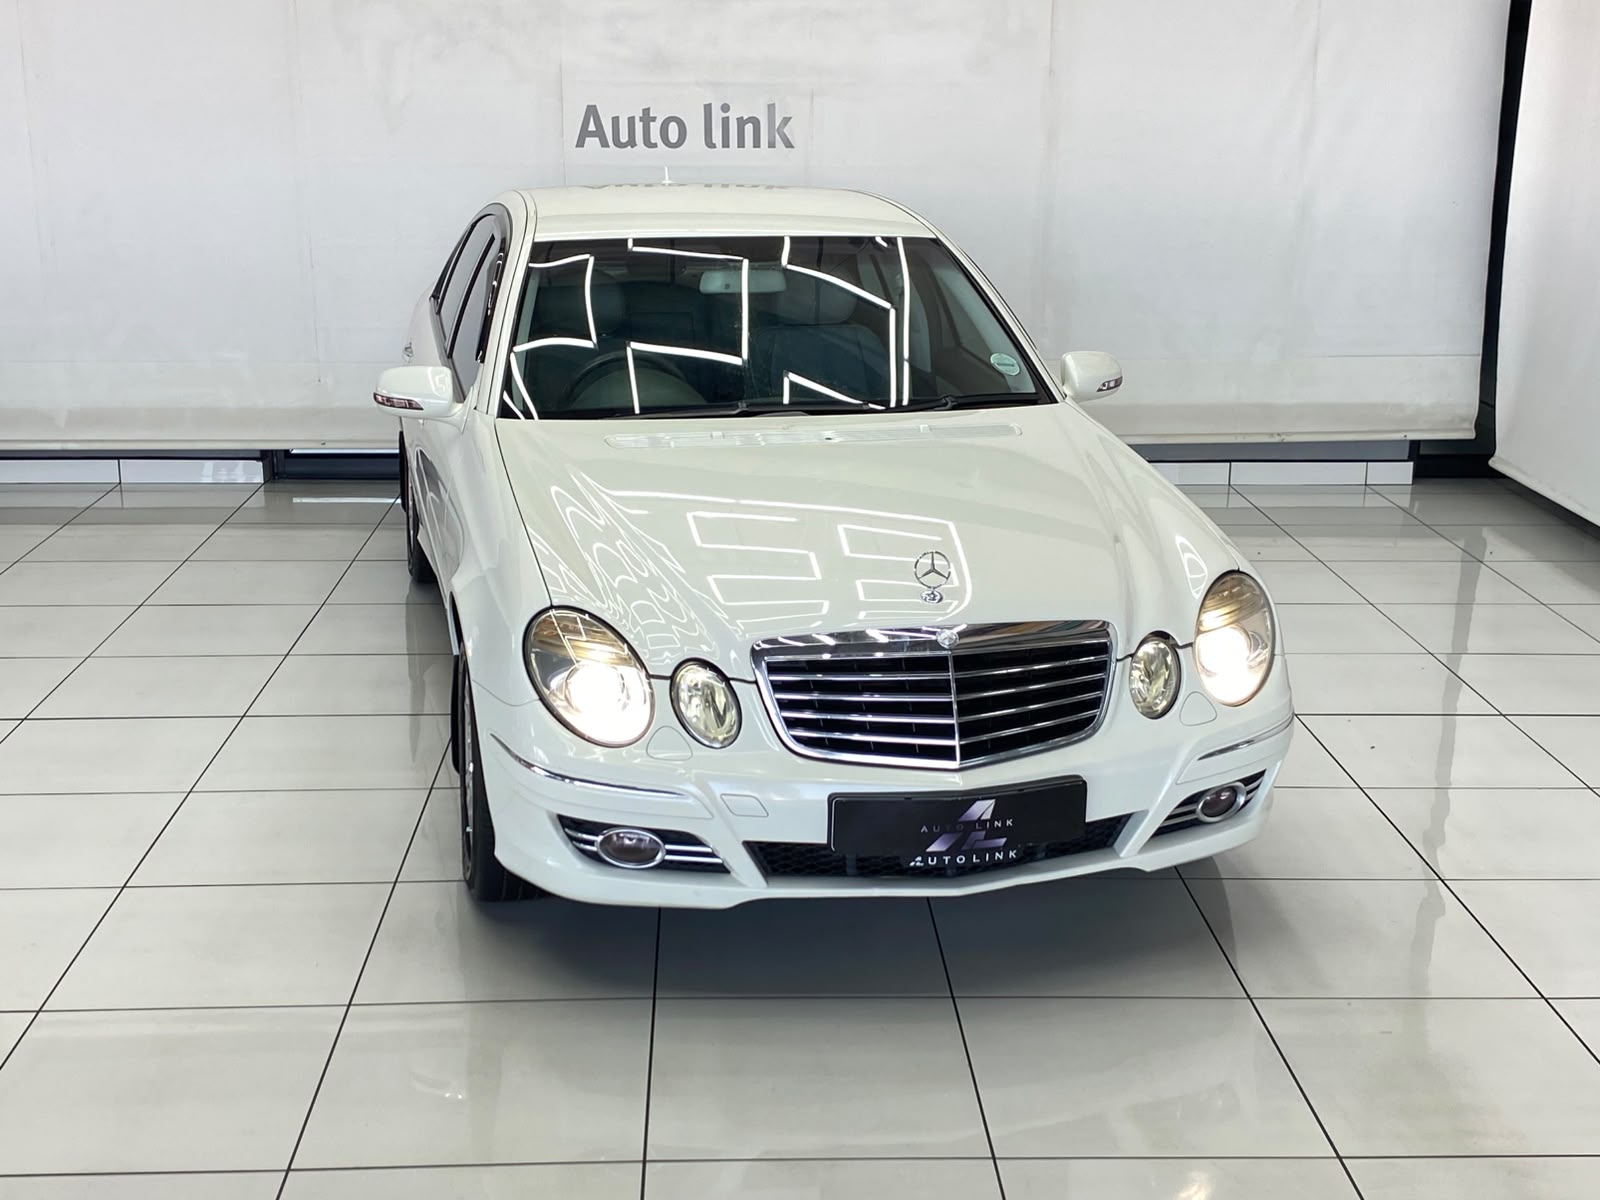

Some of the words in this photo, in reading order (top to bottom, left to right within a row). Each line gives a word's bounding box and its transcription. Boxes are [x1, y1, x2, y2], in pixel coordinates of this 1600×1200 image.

[575, 104, 688, 149] Auto
[703, 102, 795, 149] link
[920, 824, 964, 833] AUTO
[975, 818, 1014, 830] LINK
[909, 849, 1017, 867] AUTOLINK
